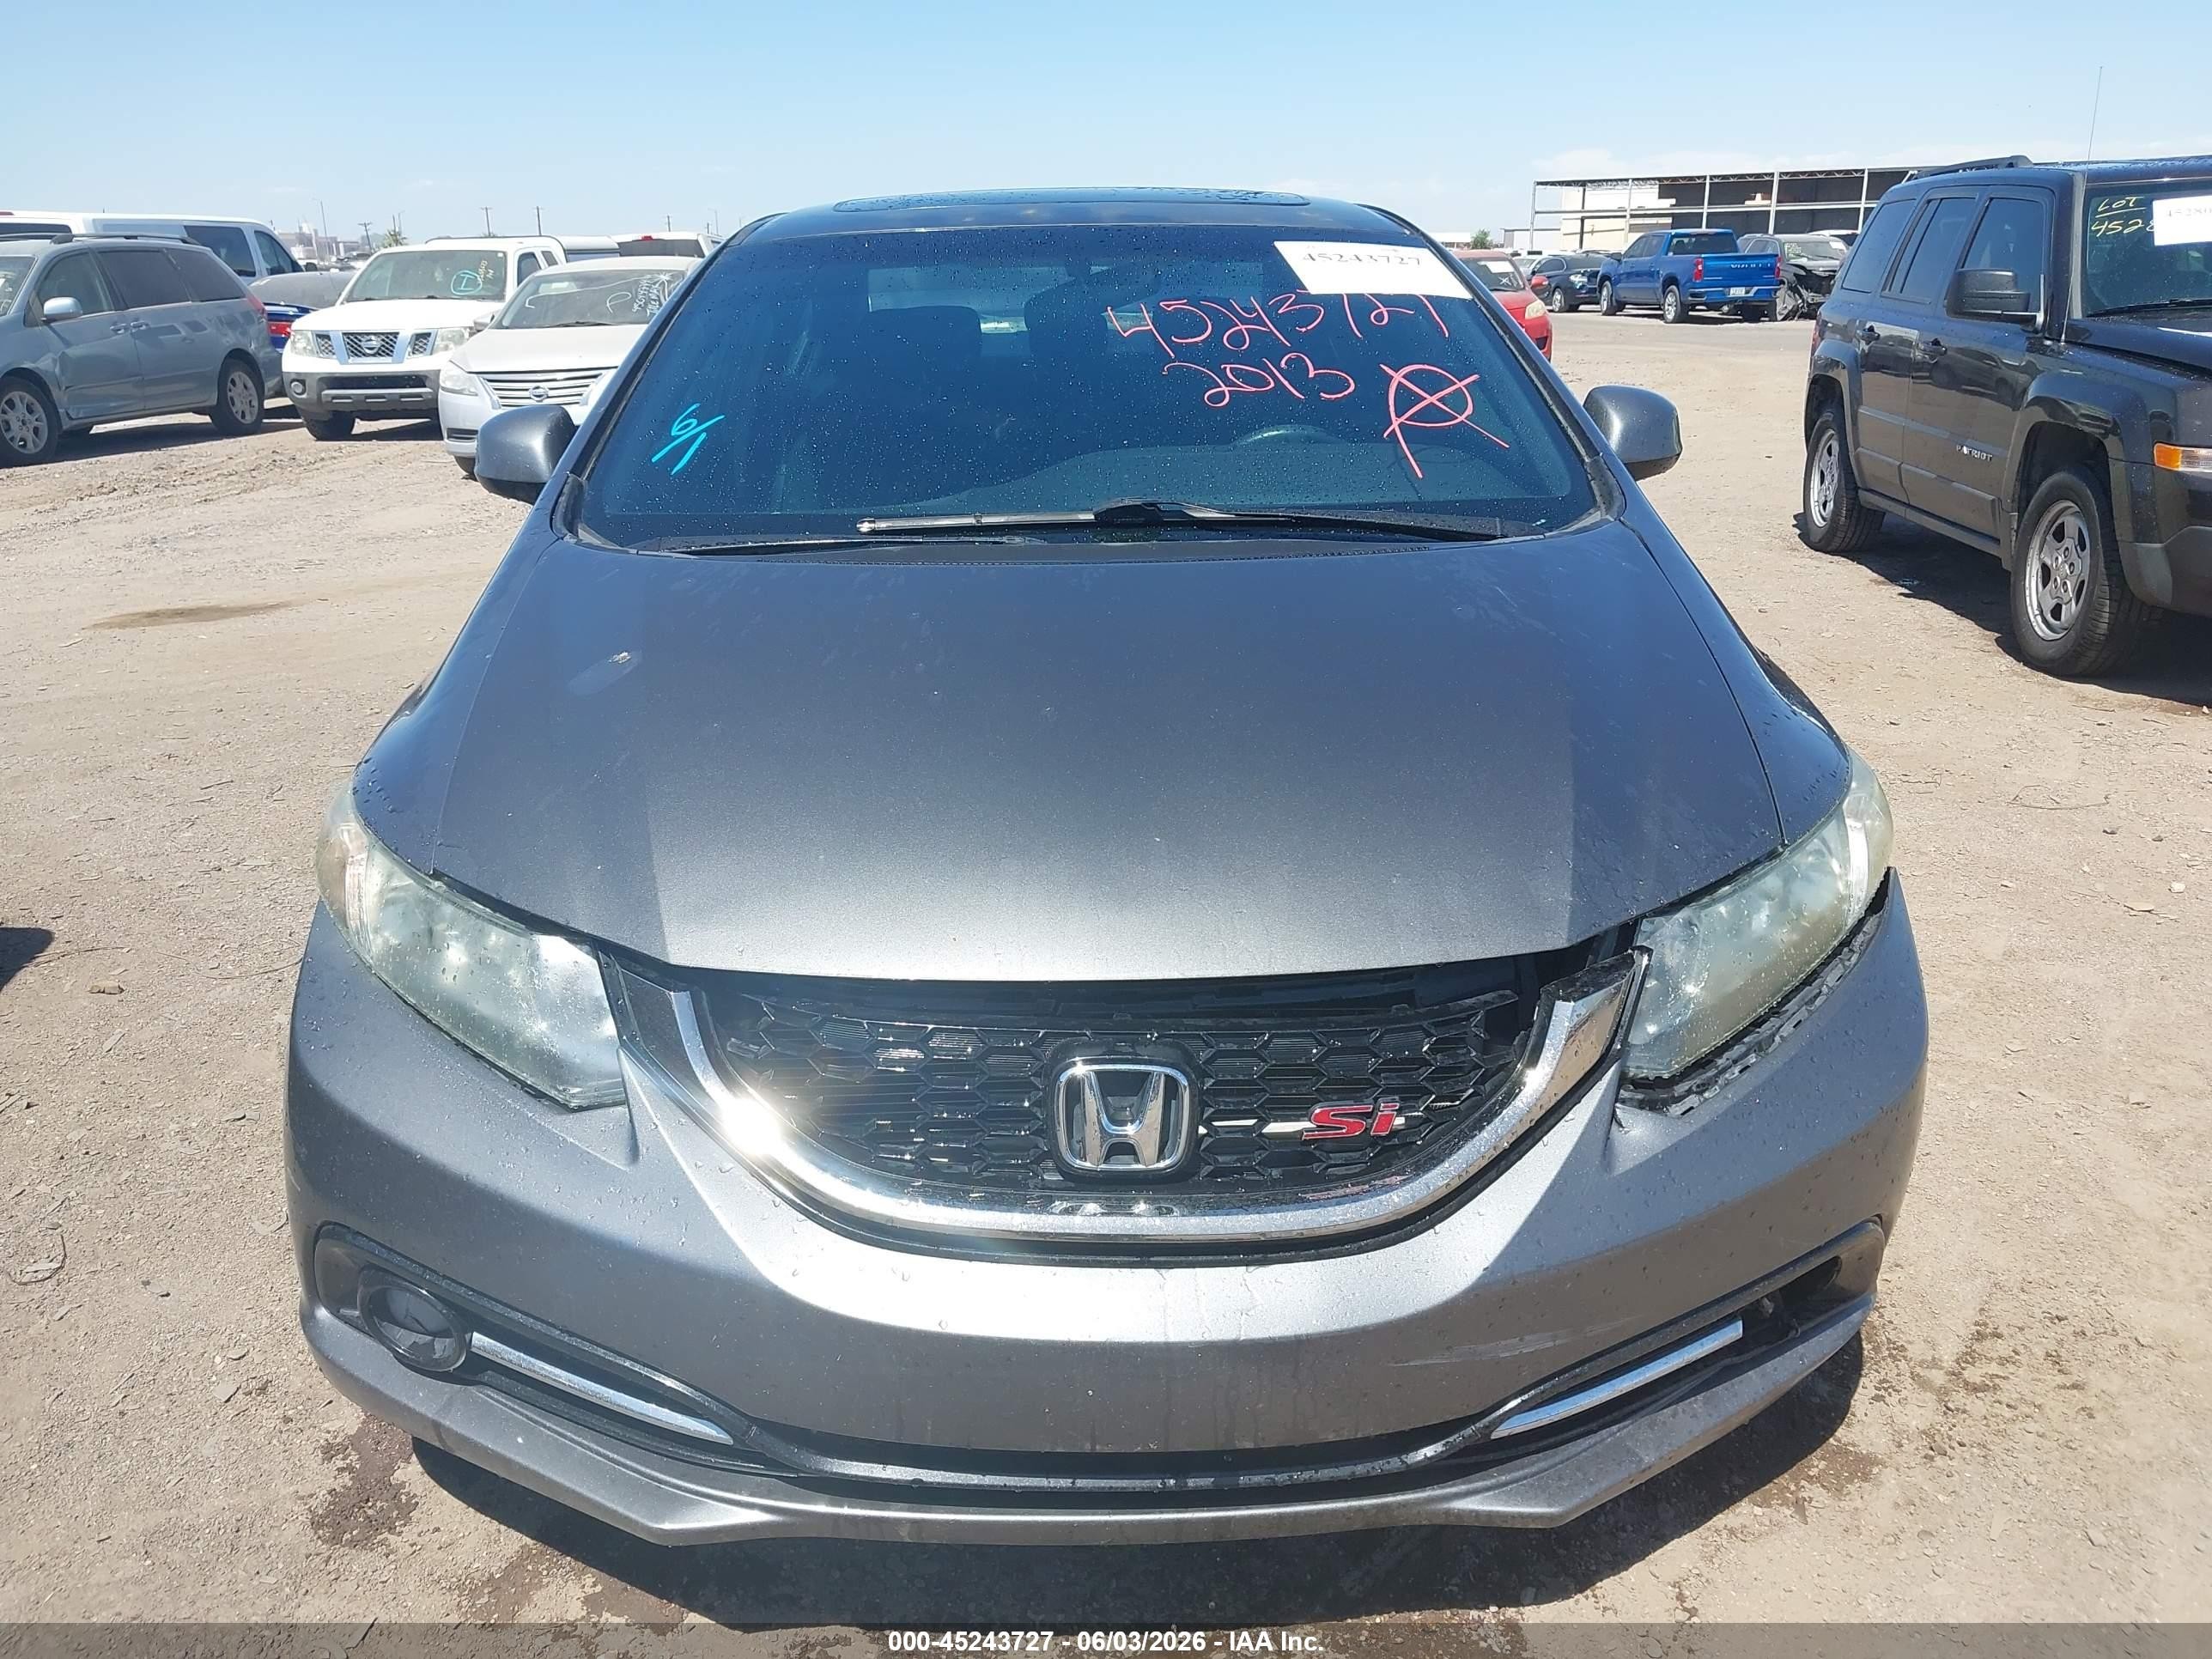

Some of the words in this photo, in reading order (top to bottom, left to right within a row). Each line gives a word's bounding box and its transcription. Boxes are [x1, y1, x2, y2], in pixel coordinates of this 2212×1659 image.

[2098, 196, 2145, 211] LOT
[1162, 352, 1356, 407] 2013
[1956, 445, 1993, 462] PATRIOT
[1301, 1096, 1401, 1141] Si
